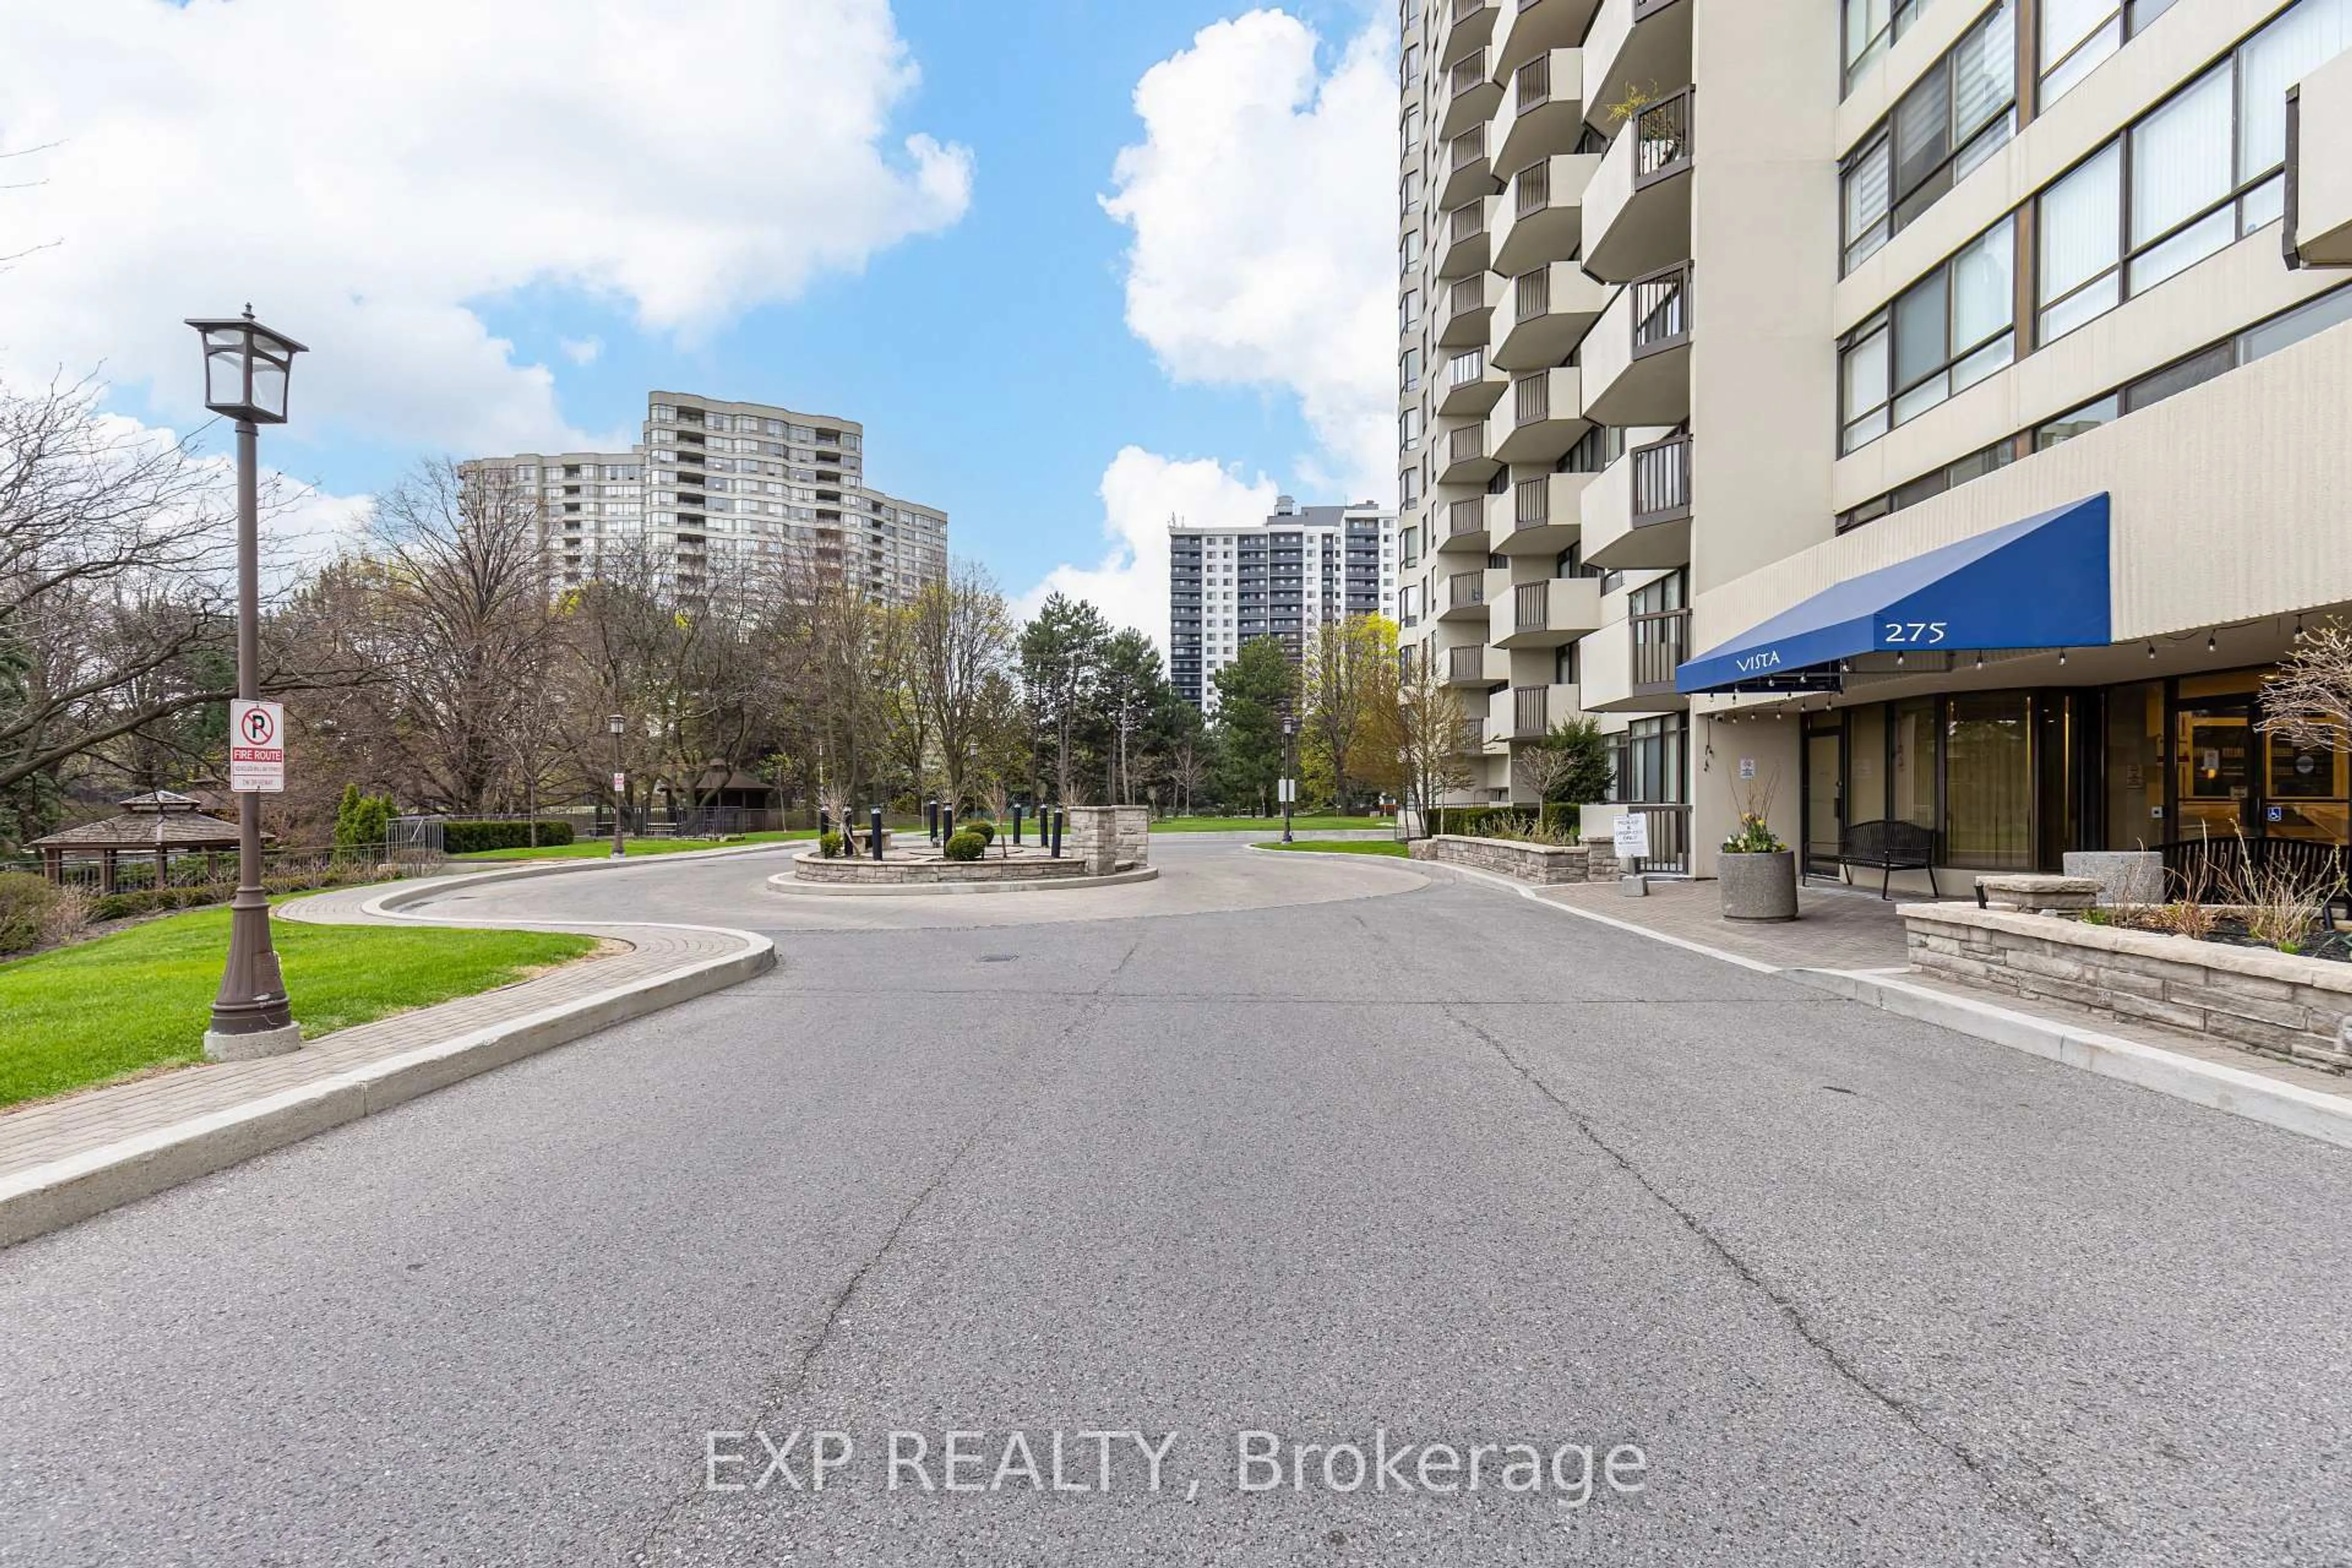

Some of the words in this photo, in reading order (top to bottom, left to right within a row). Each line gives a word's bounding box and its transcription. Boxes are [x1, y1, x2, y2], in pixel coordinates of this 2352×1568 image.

[1885, 622, 1948, 644] 275
[1736, 650, 1781, 672] VISTA
[234, 750, 253, 760] FIRE
[254, 751, 281, 761] ROUTE
